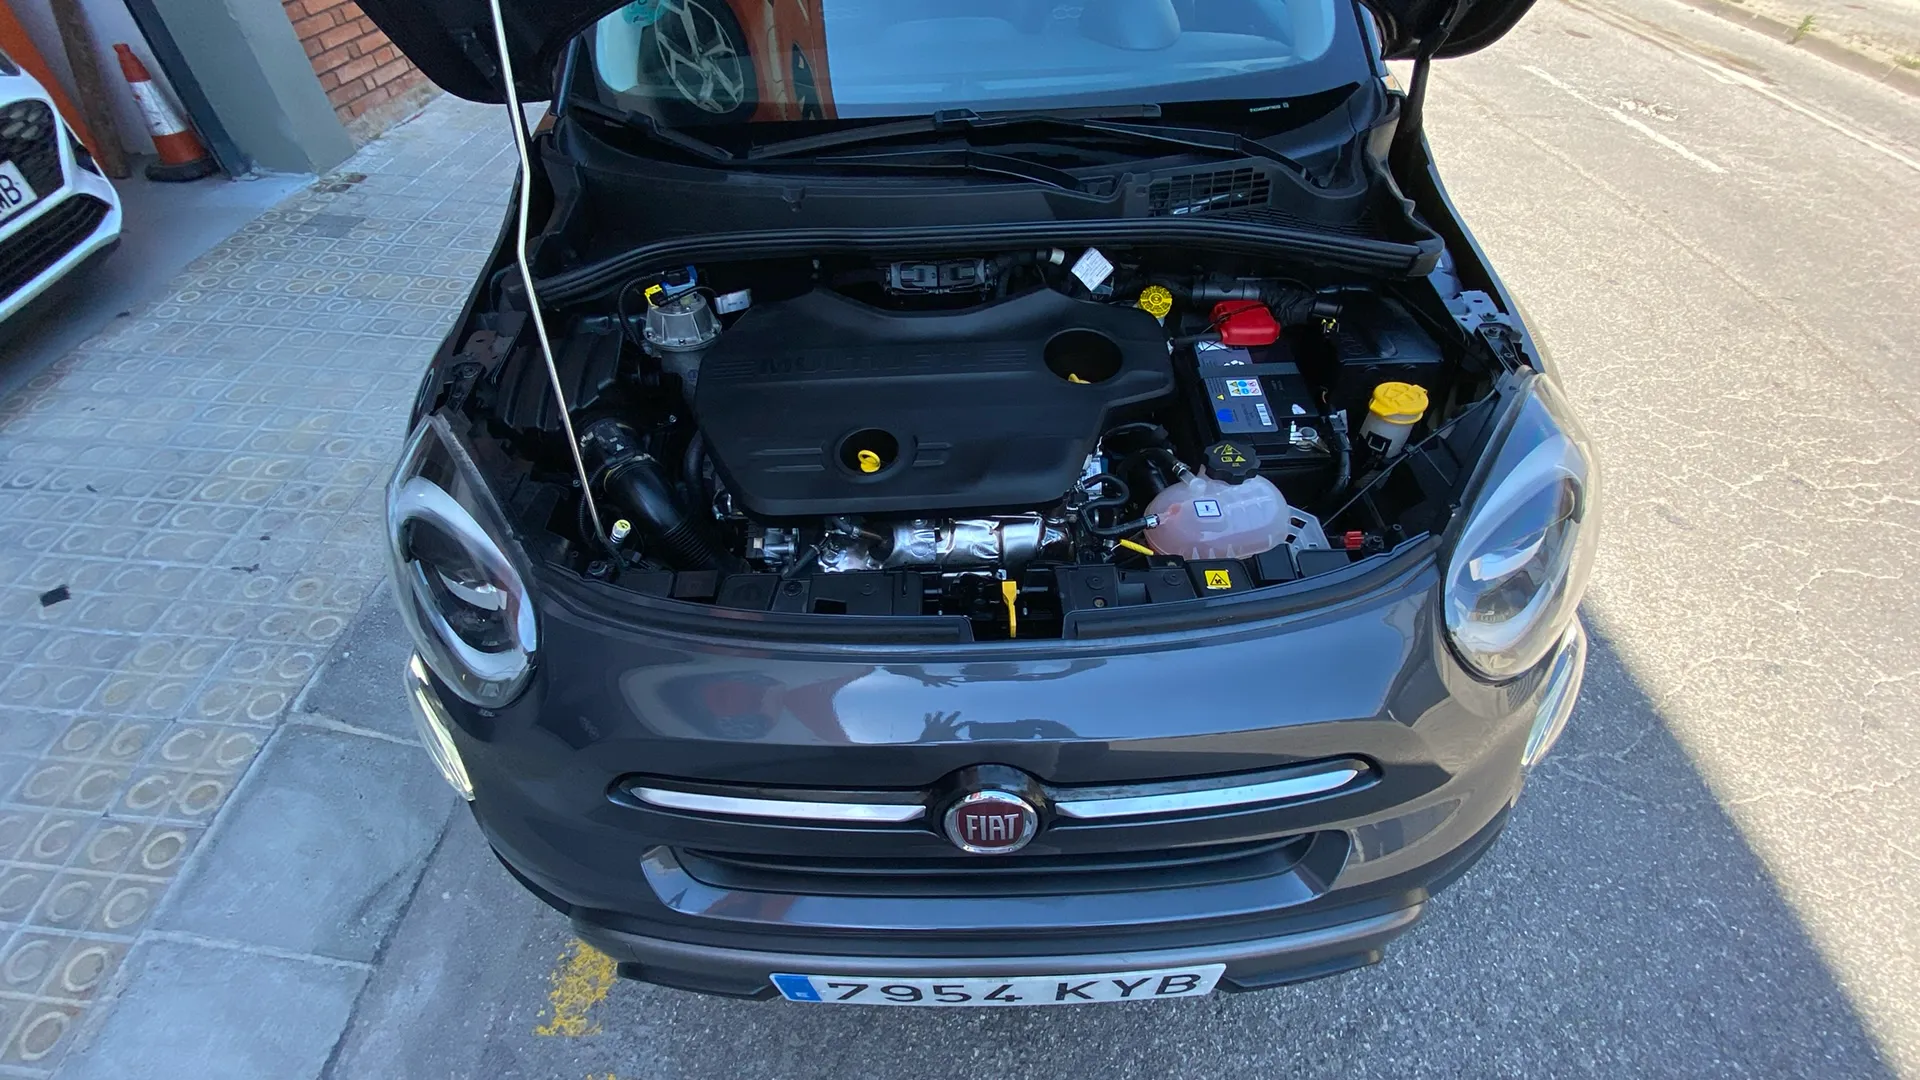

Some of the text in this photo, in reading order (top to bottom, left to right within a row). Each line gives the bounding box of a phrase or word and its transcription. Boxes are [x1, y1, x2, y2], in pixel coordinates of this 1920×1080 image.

[965, 813, 1019, 841] FIAT
[827, 974, 1201, 1003] 7954 KYB
